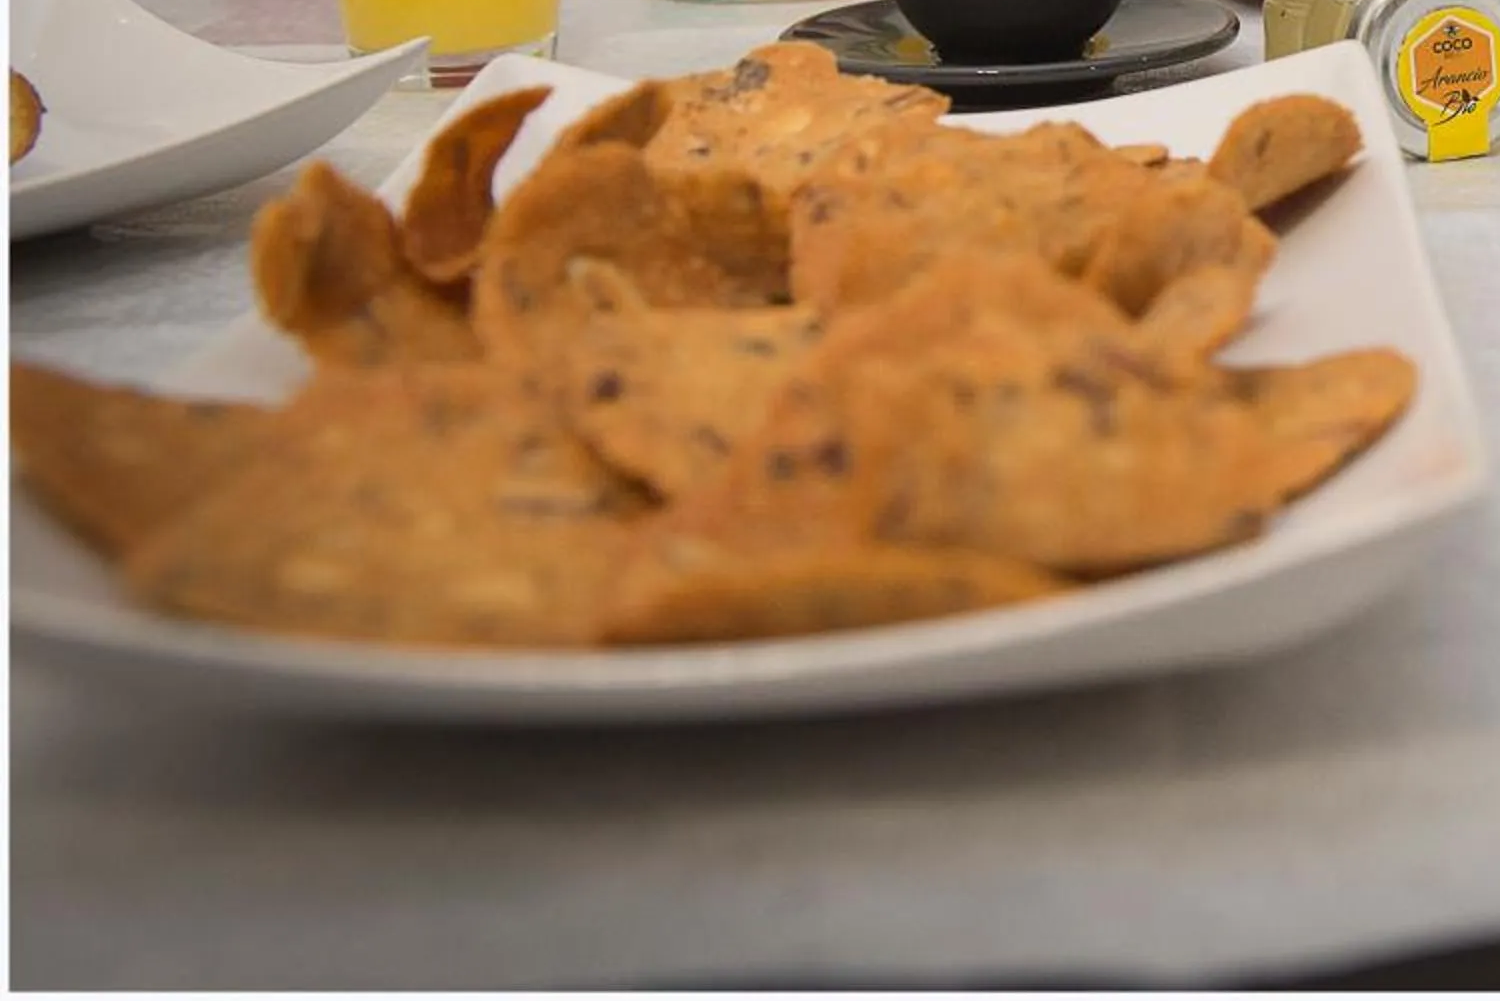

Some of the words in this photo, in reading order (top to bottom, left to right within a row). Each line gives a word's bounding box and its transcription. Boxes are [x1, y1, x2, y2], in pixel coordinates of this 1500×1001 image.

[1433, 37, 1473, 54] COCO
[1416, 66, 1487, 95] Arancio
[1432, 89, 1476, 127] Bio
